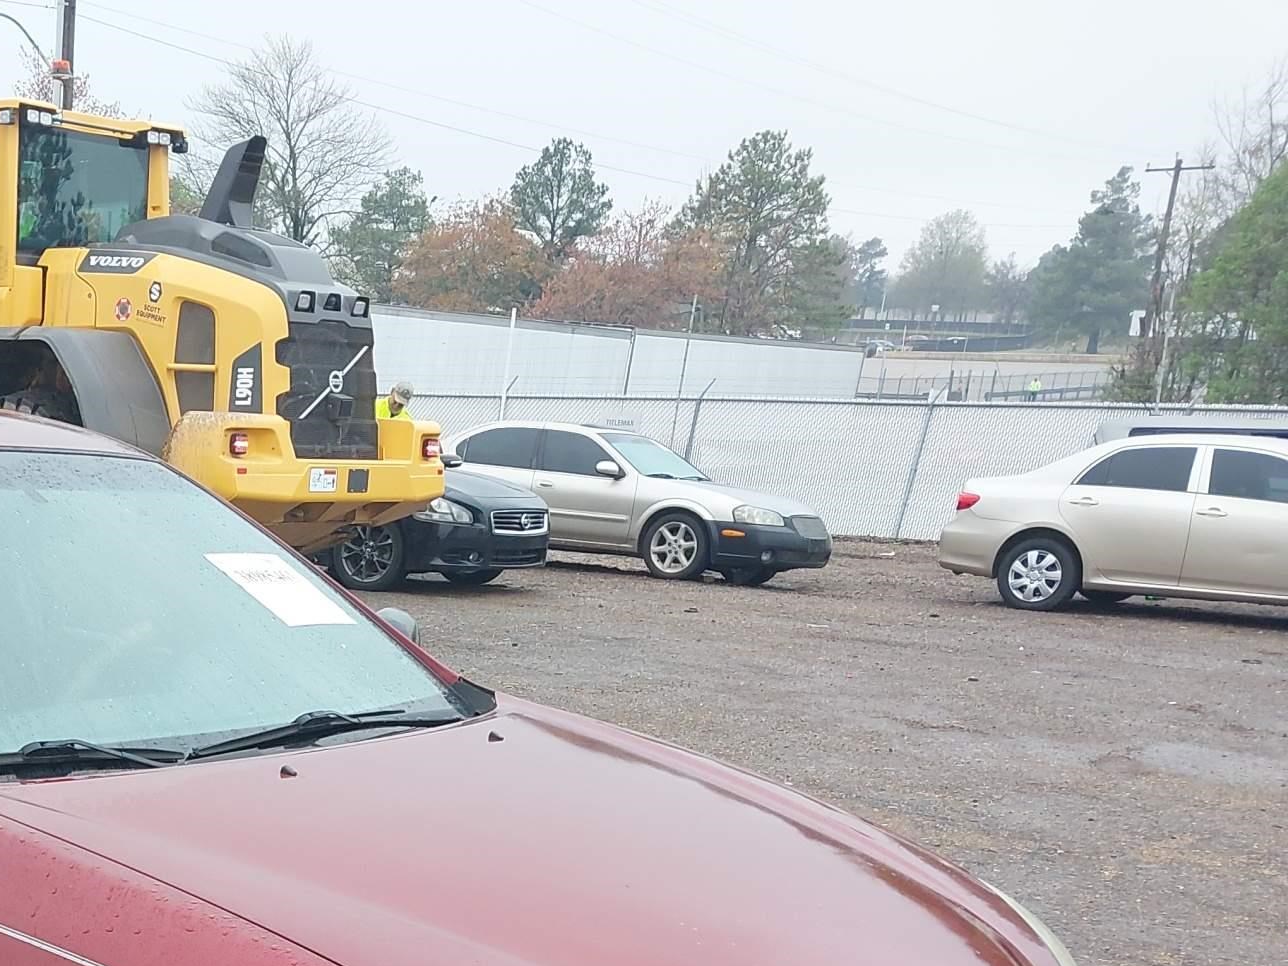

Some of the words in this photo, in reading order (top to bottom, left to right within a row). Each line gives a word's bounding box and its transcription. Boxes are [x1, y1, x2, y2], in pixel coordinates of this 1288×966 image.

[89, 255, 145, 268] VOLVO
[143, 303, 161, 315] SCOTT
[136, 309, 167, 324] EQUIPMENT
[234, 367, 255, 406] L90H
